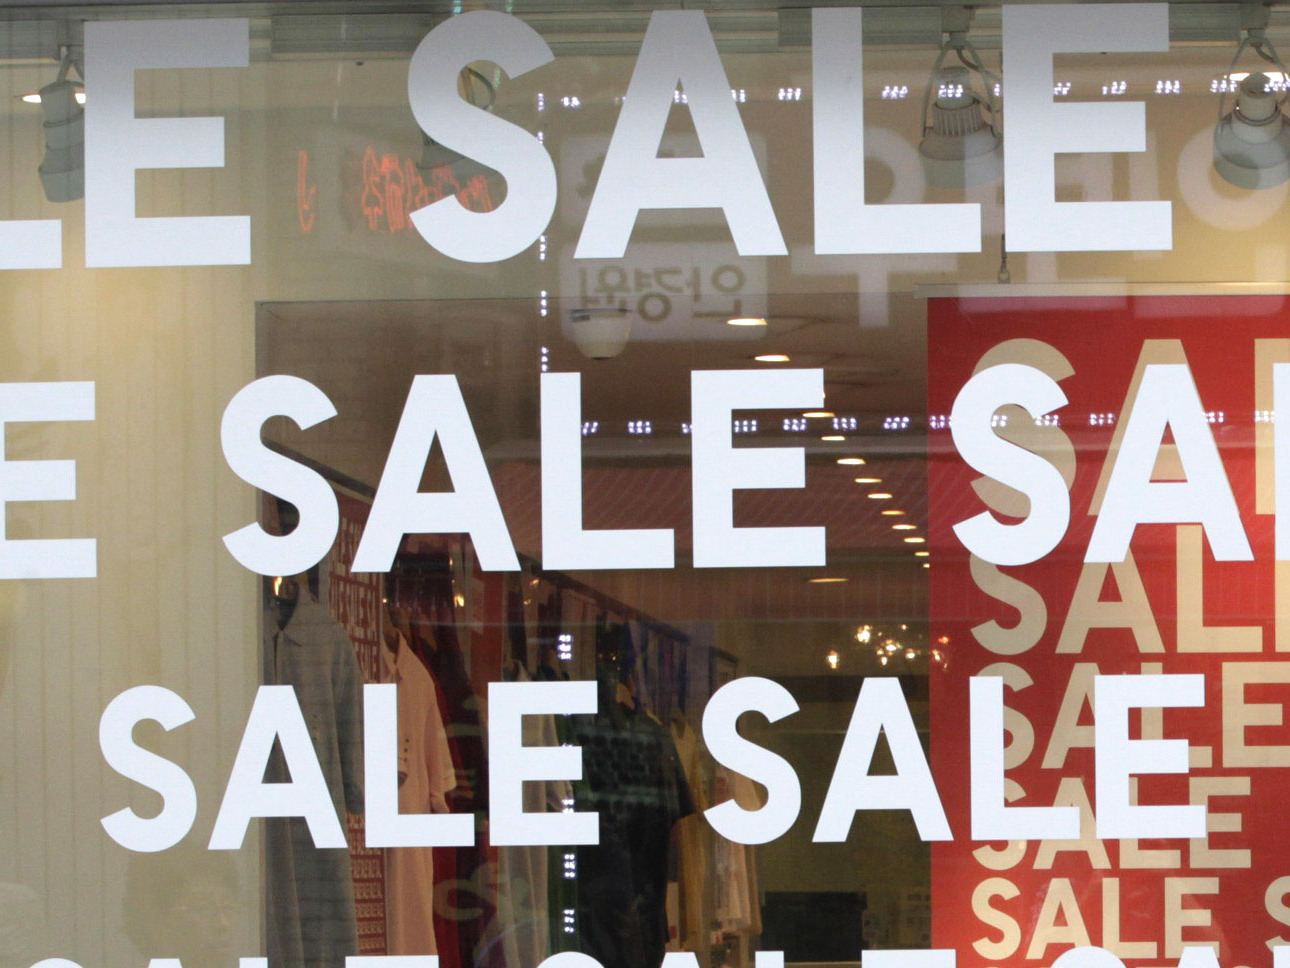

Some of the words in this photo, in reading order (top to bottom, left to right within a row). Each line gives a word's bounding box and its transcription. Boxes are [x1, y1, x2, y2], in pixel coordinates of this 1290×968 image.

[408, 3, 1172, 264] SALE
[221, 369, 825, 576] SALE
[100, 681, 599, 852] SALE
[702, 675, 1206, 844] SALE
[972, 876, 1220, 960] SALE
